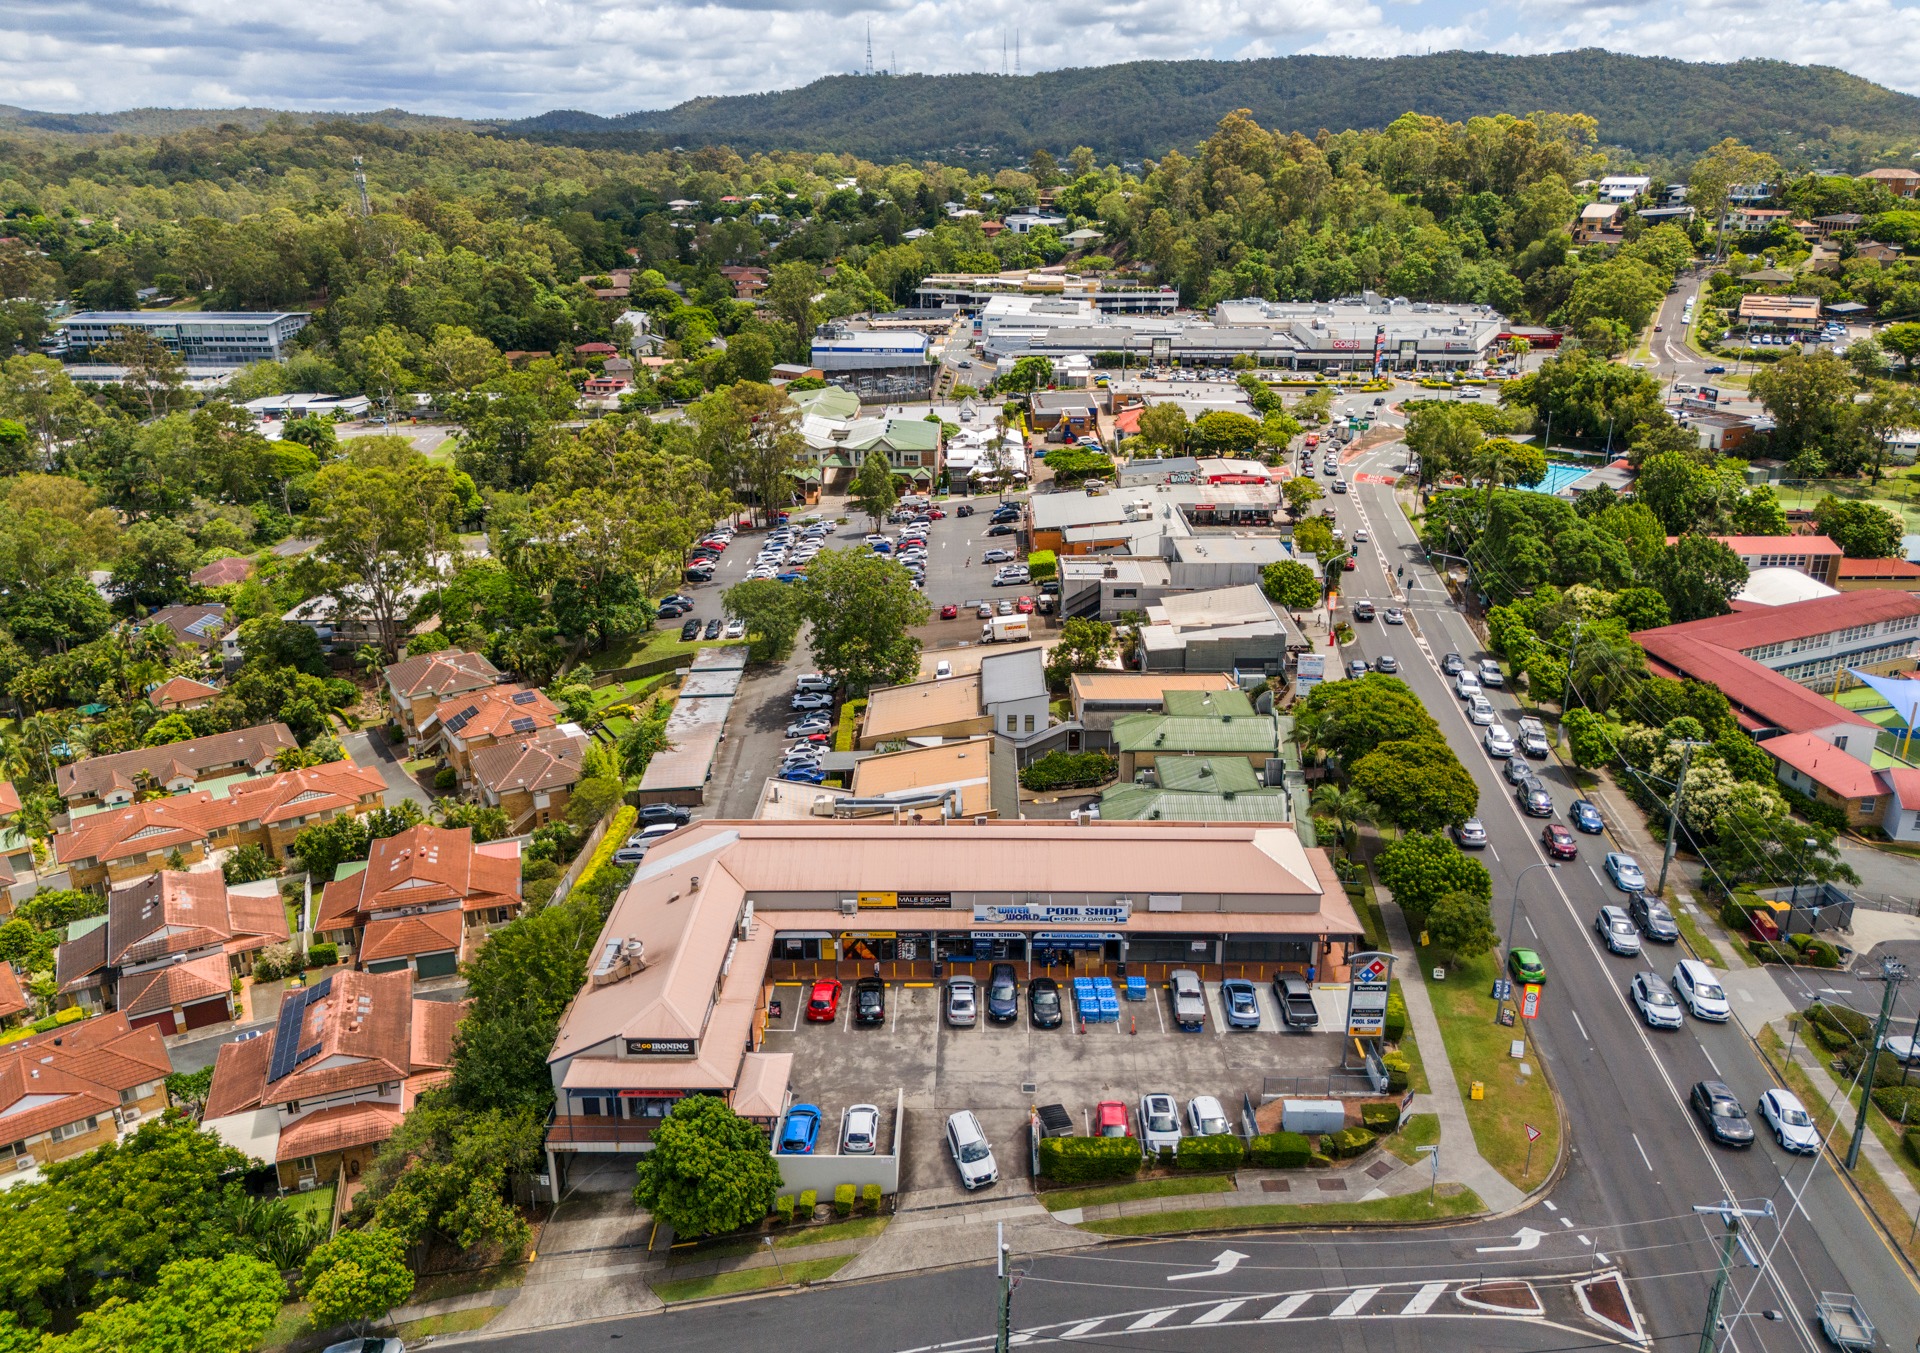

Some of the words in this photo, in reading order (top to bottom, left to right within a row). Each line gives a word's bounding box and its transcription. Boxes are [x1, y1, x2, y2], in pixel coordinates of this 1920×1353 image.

[997, 906, 1030, 914] WATER
[1046, 907, 1082, 916] POOL
[1085, 907, 1123, 916] SHOP
[1005, 913, 1040, 921] WORLD
